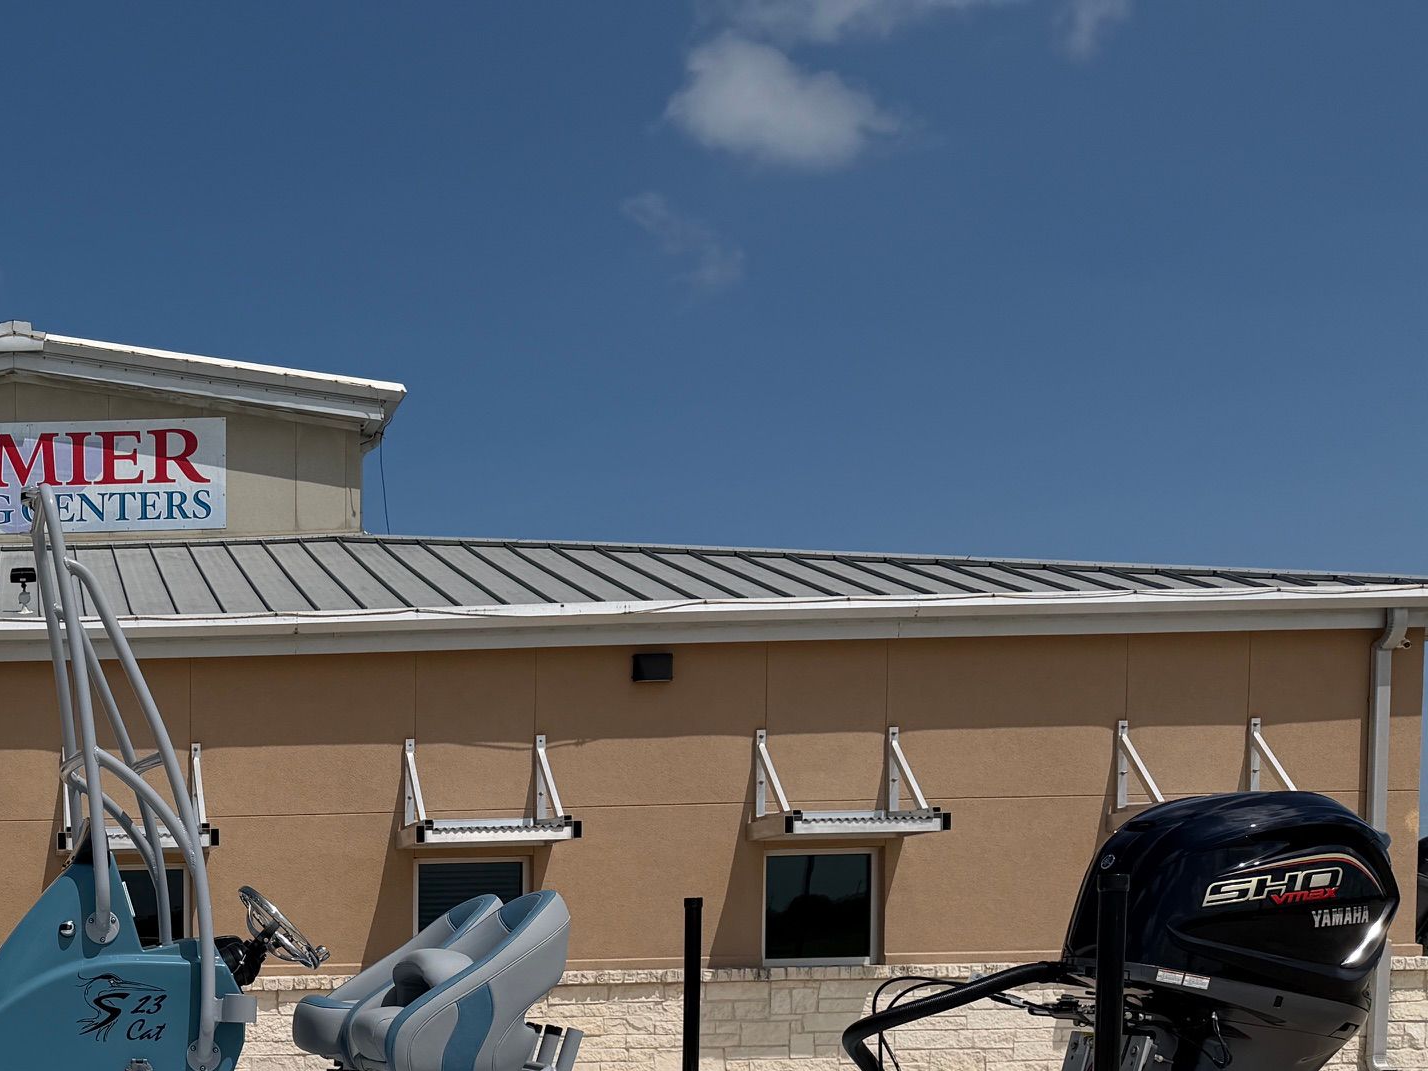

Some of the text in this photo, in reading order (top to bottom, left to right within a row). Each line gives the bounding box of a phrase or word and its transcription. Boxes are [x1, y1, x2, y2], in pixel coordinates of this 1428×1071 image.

[1202, 866, 1344, 907] SHO
[1312, 905, 1370, 928] YAMAHA
[130, 993, 168, 1015] 23
[126, 1019, 167, 1041] Cat
